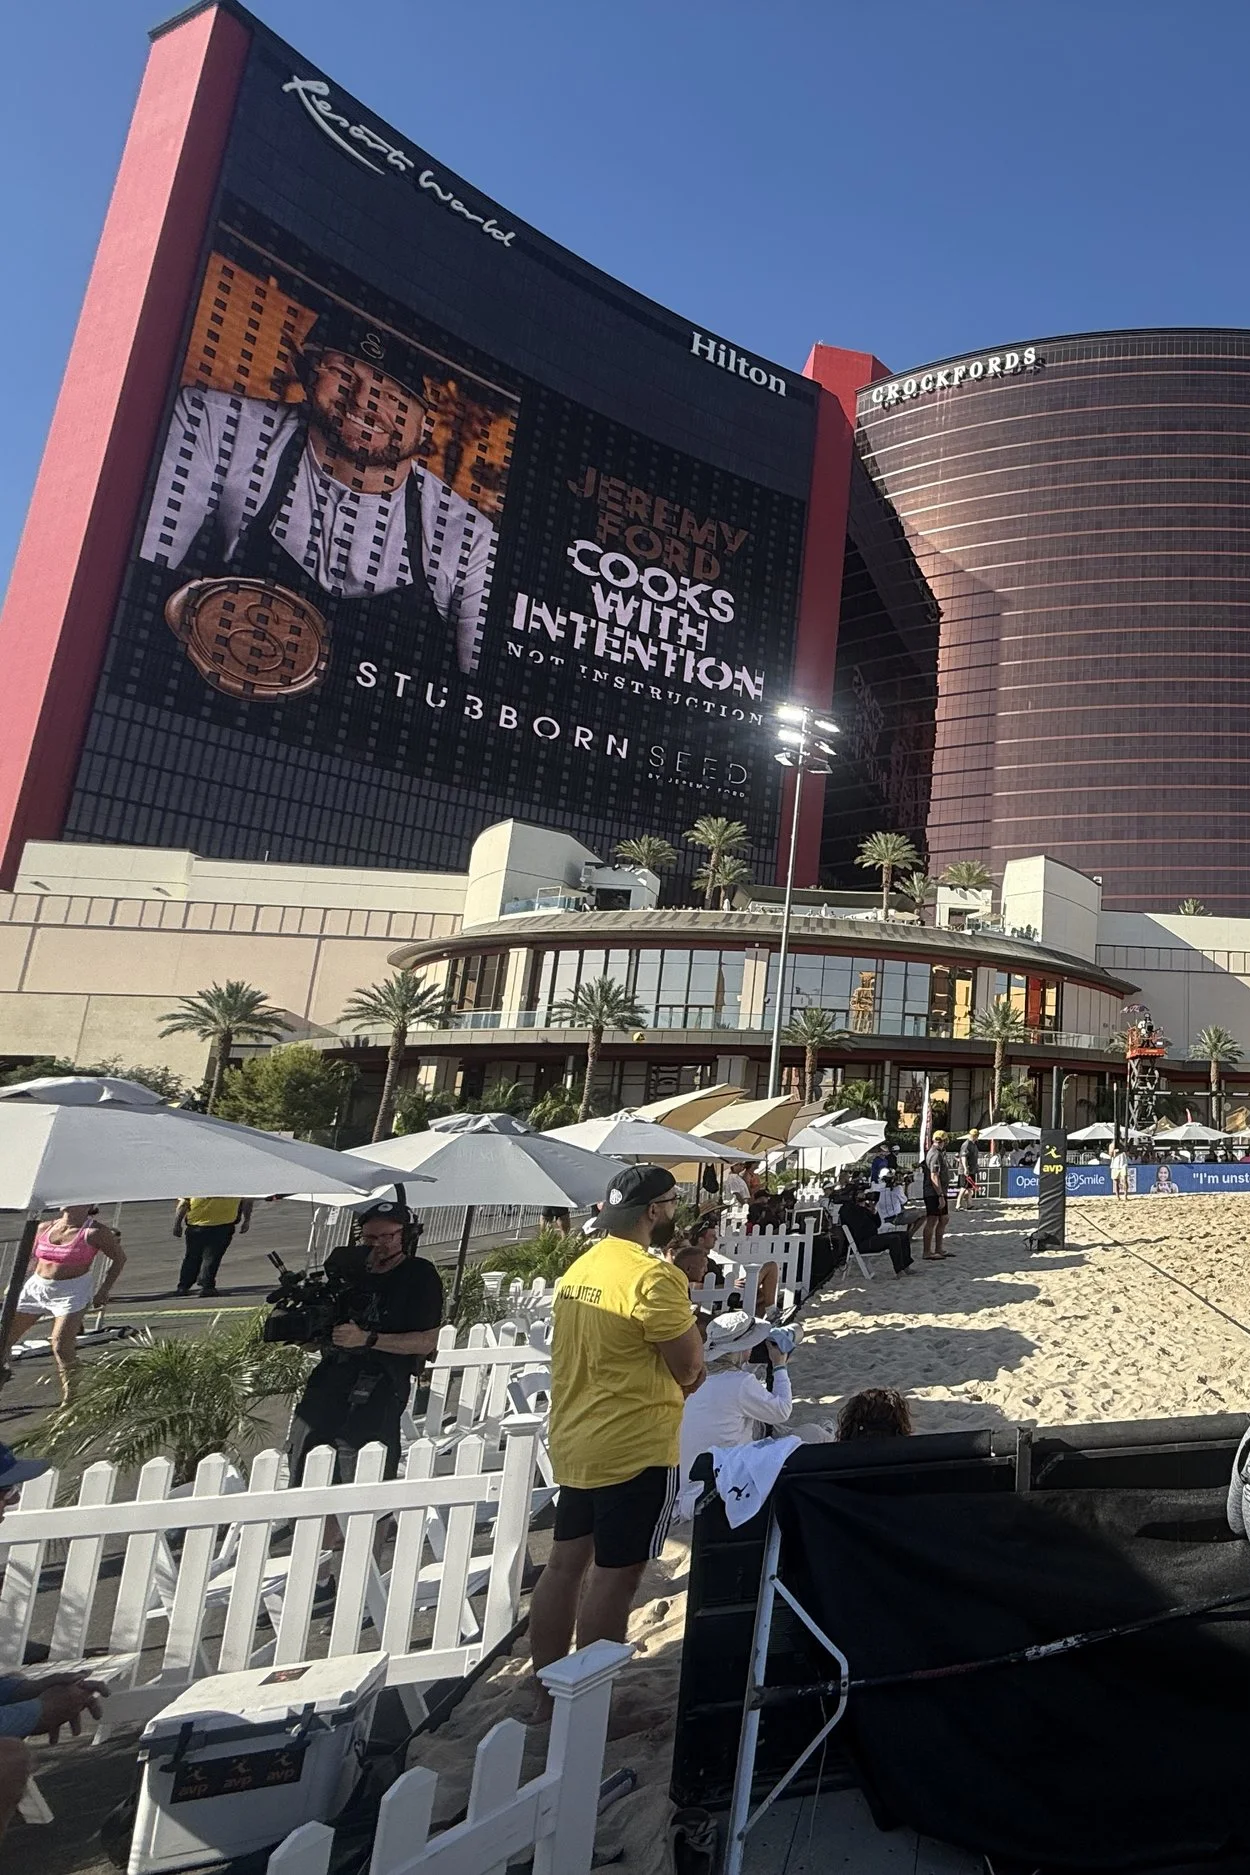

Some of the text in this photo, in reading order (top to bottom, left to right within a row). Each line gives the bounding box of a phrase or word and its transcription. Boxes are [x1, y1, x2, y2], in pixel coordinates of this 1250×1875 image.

[281, 75, 516, 247] Resorts World
[690, 331, 787, 397] Hilton
[872, 348, 1036, 403] CROCKFORDS
[567, 466, 749, 554] JEREMY
[596, 511, 721, 581] FORD
[567, 539, 735, 624] COOKS
[591, 581, 709, 651] WITH
[512, 591, 765, 702] INTENTION
[506, 641, 764, 726] NOT INSTRUCTION
[356, 660, 748, 785] STUBBORN SEED
[978, 1171, 987, 1181] 10
[1042, 1163, 1064, 1175] avp
[1080, 1173, 1105, 1186] Smile
[1192, 1172, 1220, 1185] "I'm
